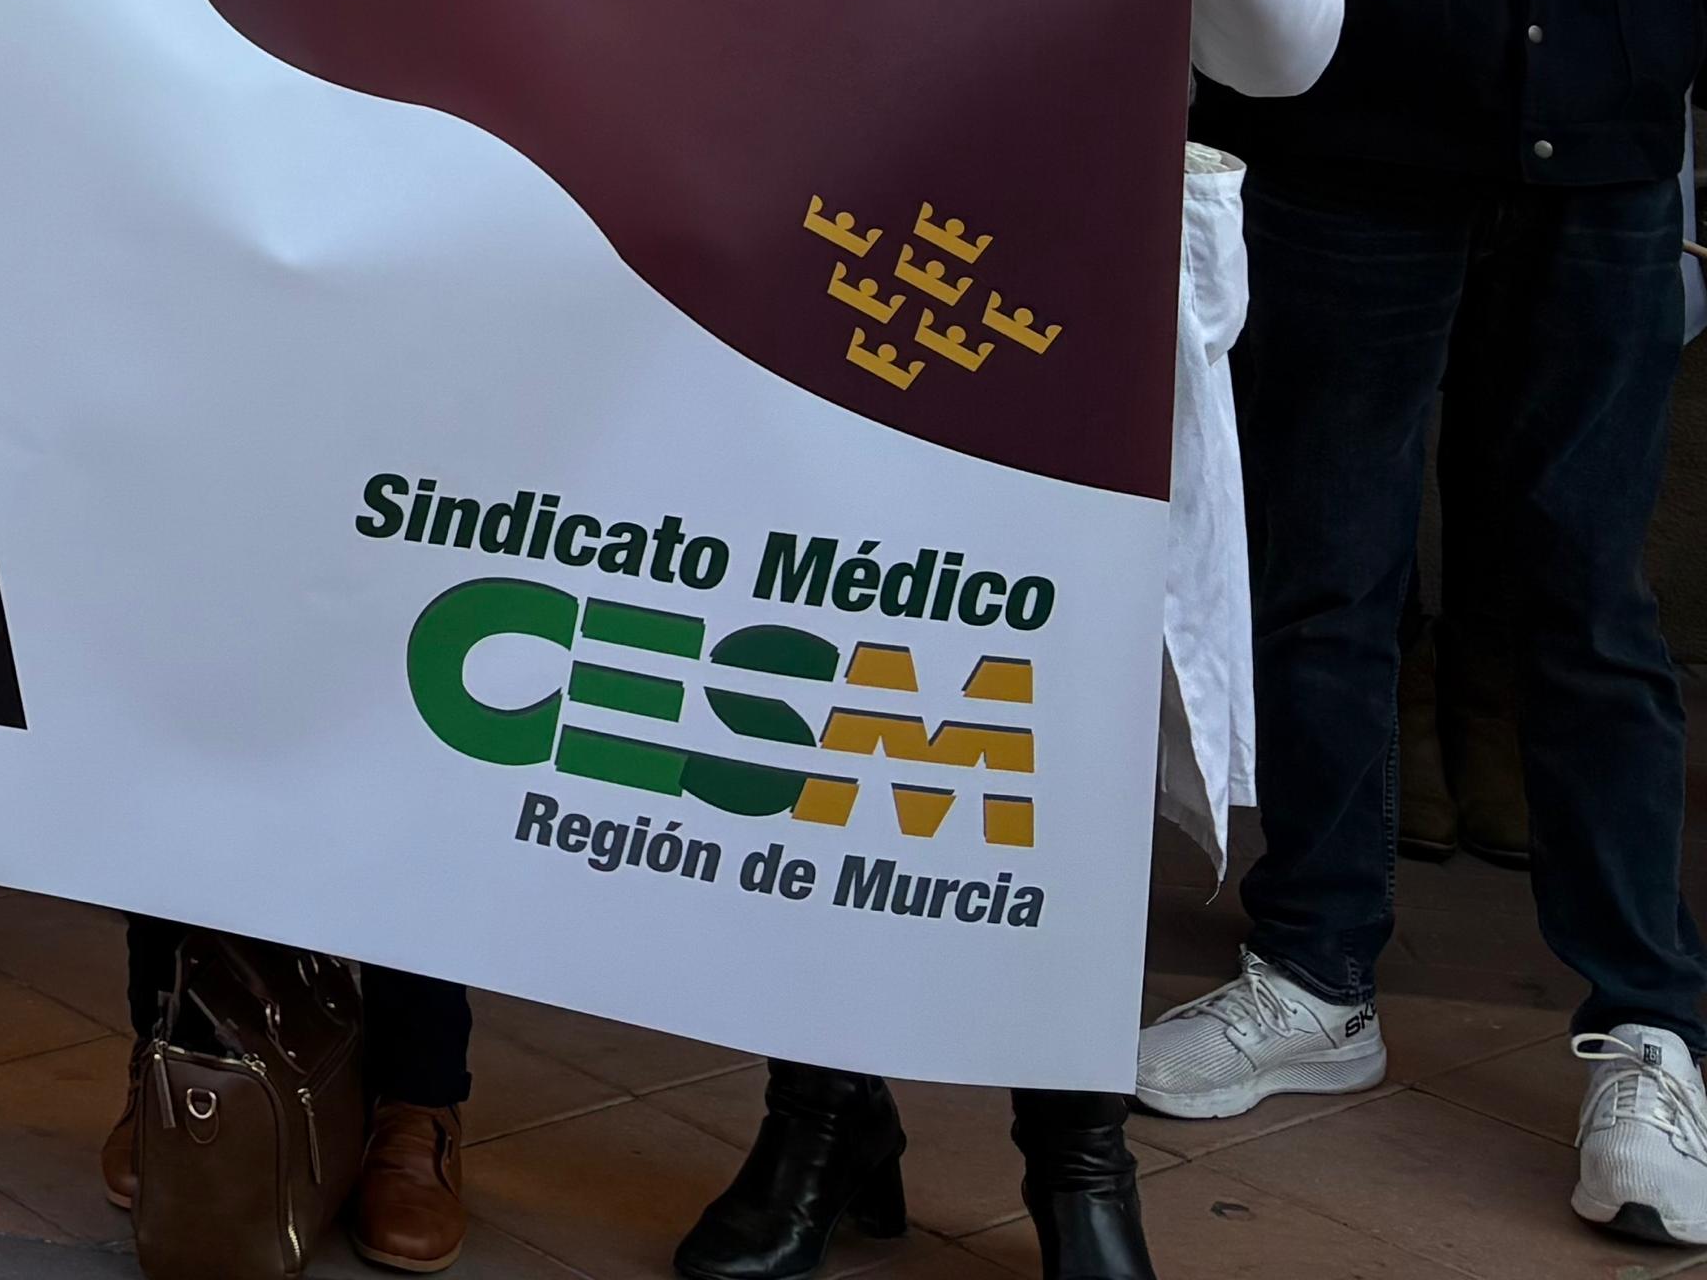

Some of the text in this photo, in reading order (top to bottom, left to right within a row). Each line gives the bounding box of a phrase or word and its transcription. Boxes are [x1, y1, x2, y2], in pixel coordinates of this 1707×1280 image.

[354, 471, 1056, 633] Sindicato Médico
[405, 575, 1035, 850] CESM
[515, 791, 1045, 930] Región de Murcia
